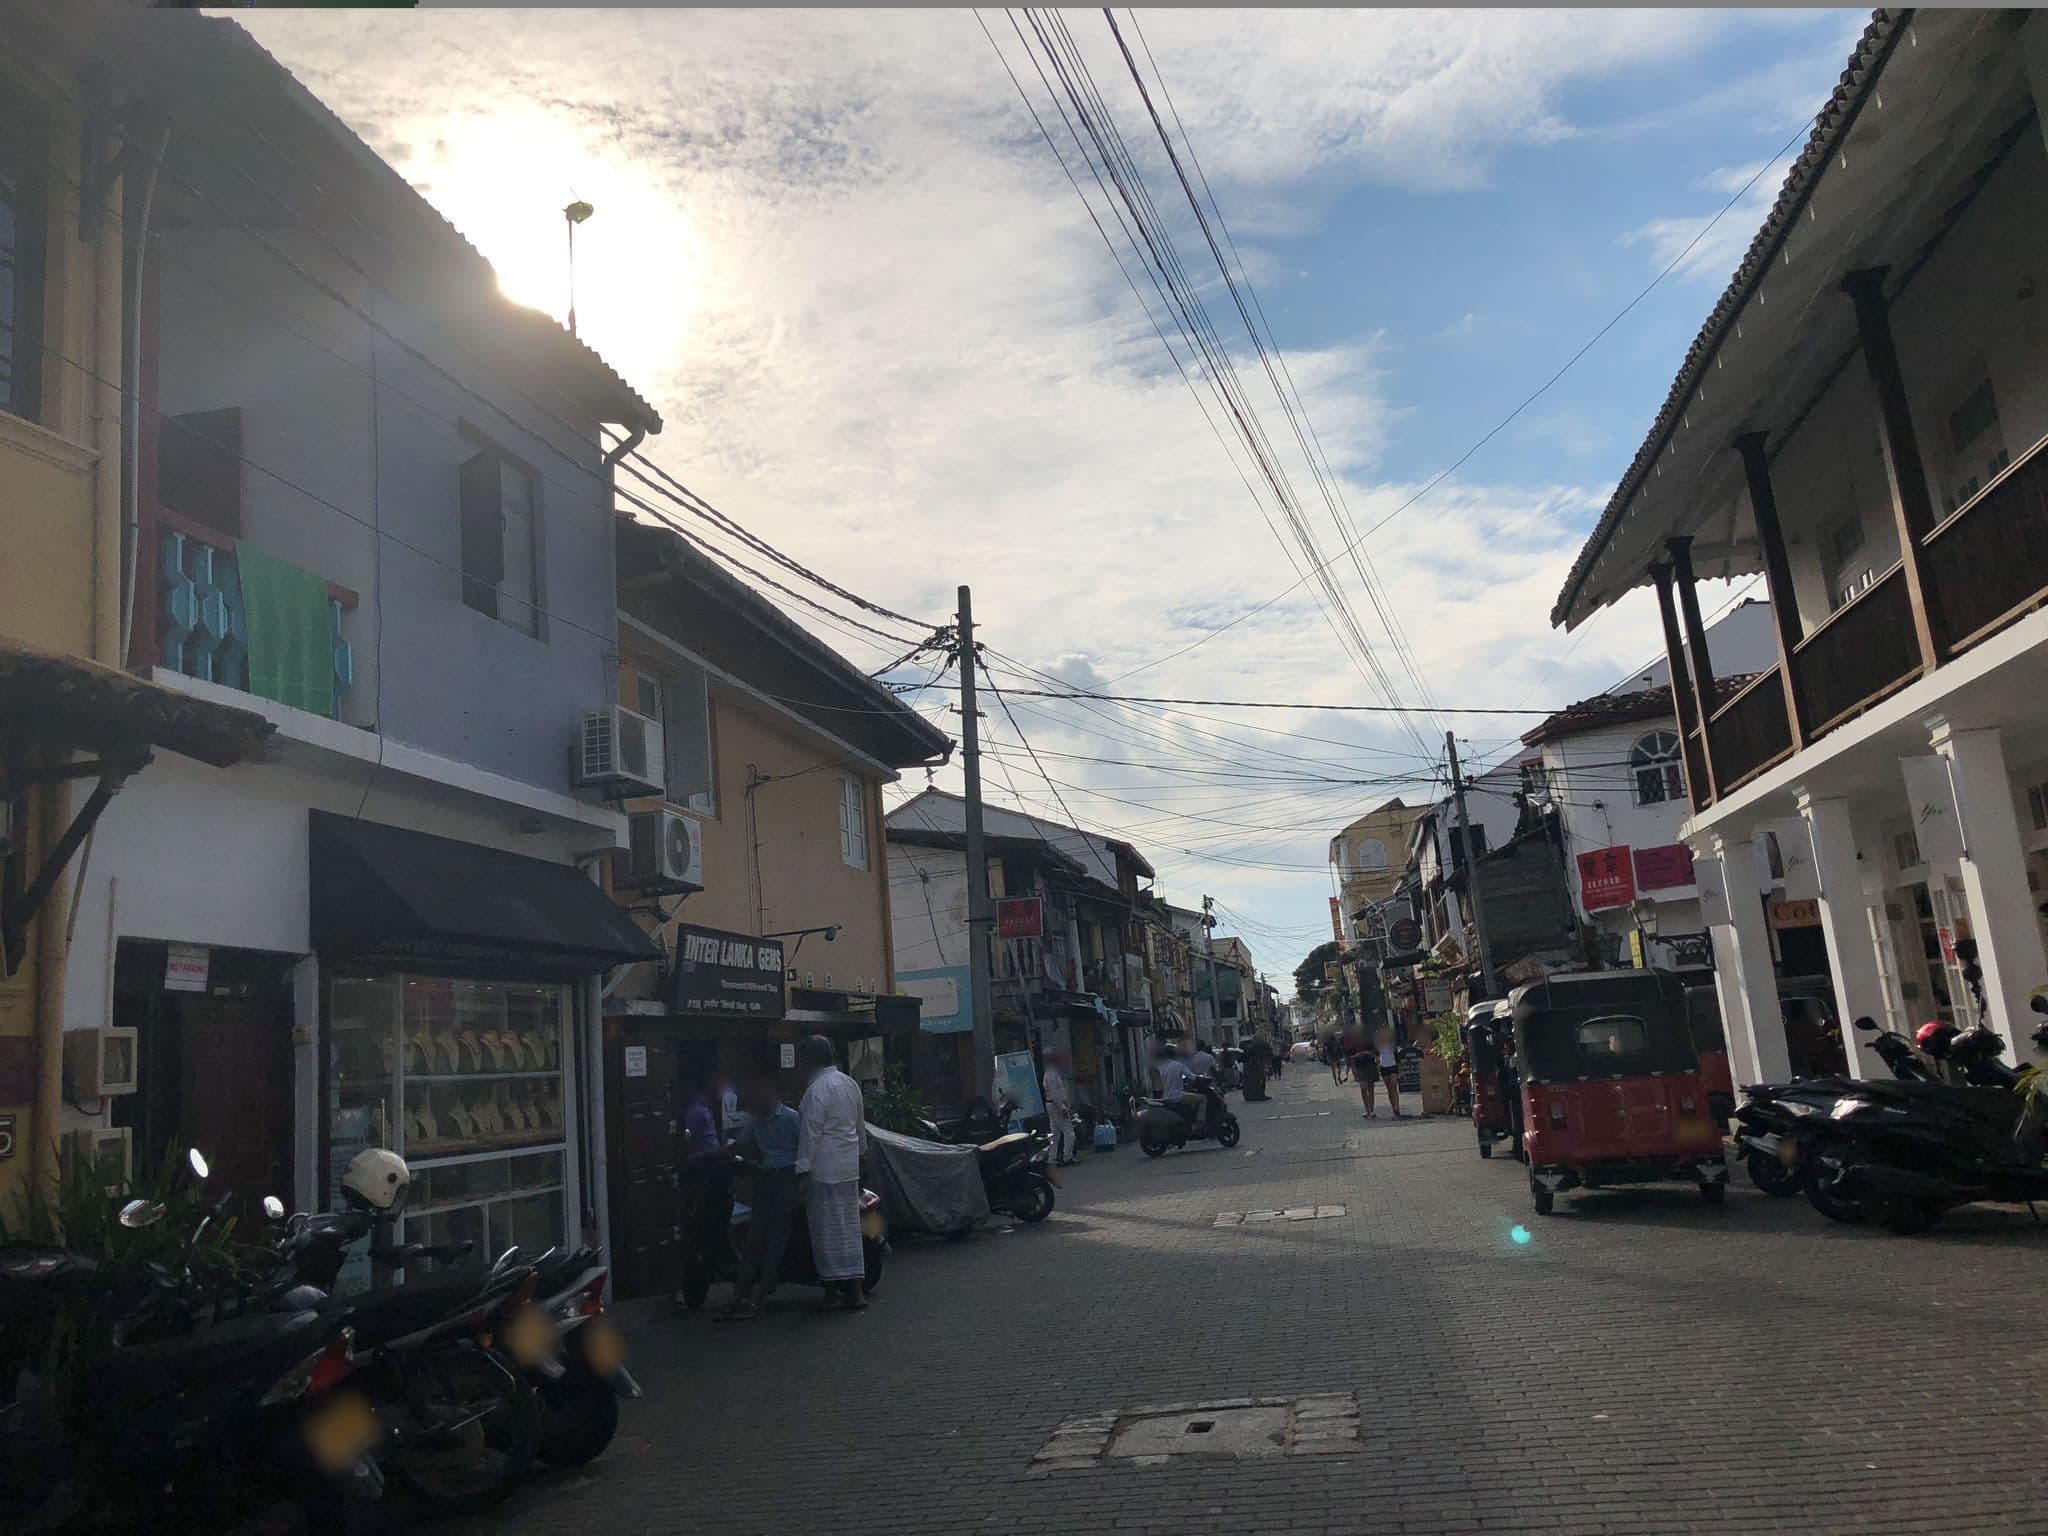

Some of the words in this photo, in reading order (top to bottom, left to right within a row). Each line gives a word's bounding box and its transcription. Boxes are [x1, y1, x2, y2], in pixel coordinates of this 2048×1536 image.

[684, 934, 719, 965] INTER
[720, 940, 754, 969] LANKA
[758, 947, 782, 973] GEMS
